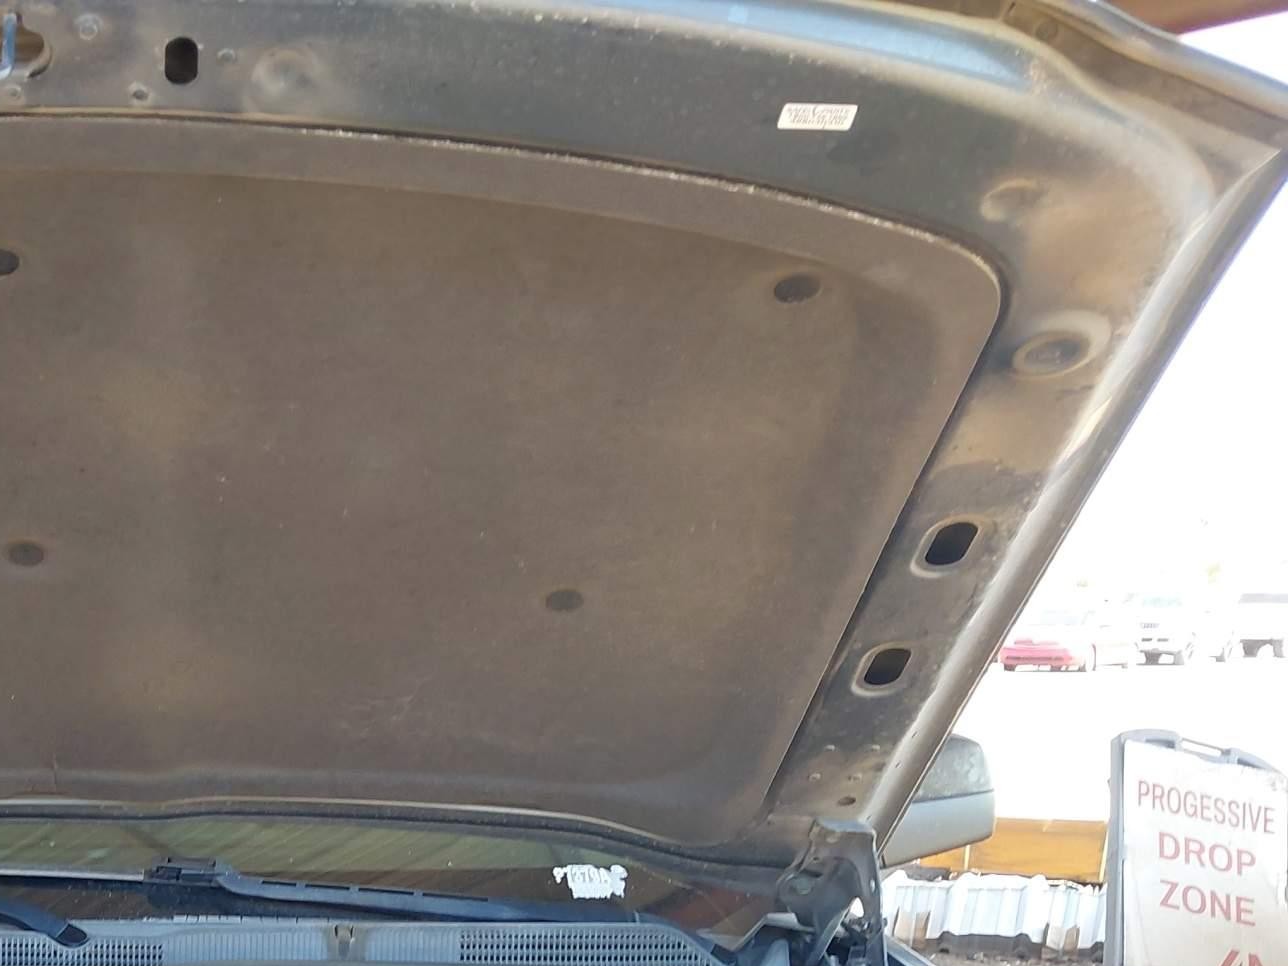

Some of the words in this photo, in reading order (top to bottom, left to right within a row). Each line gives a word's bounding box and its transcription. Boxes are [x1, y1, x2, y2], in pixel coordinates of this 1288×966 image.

[1138, 779, 1275, 834] PROGESSIVE
[1158, 831, 1257, 877] DROP
[1159, 878, 1256, 927] ZONE
